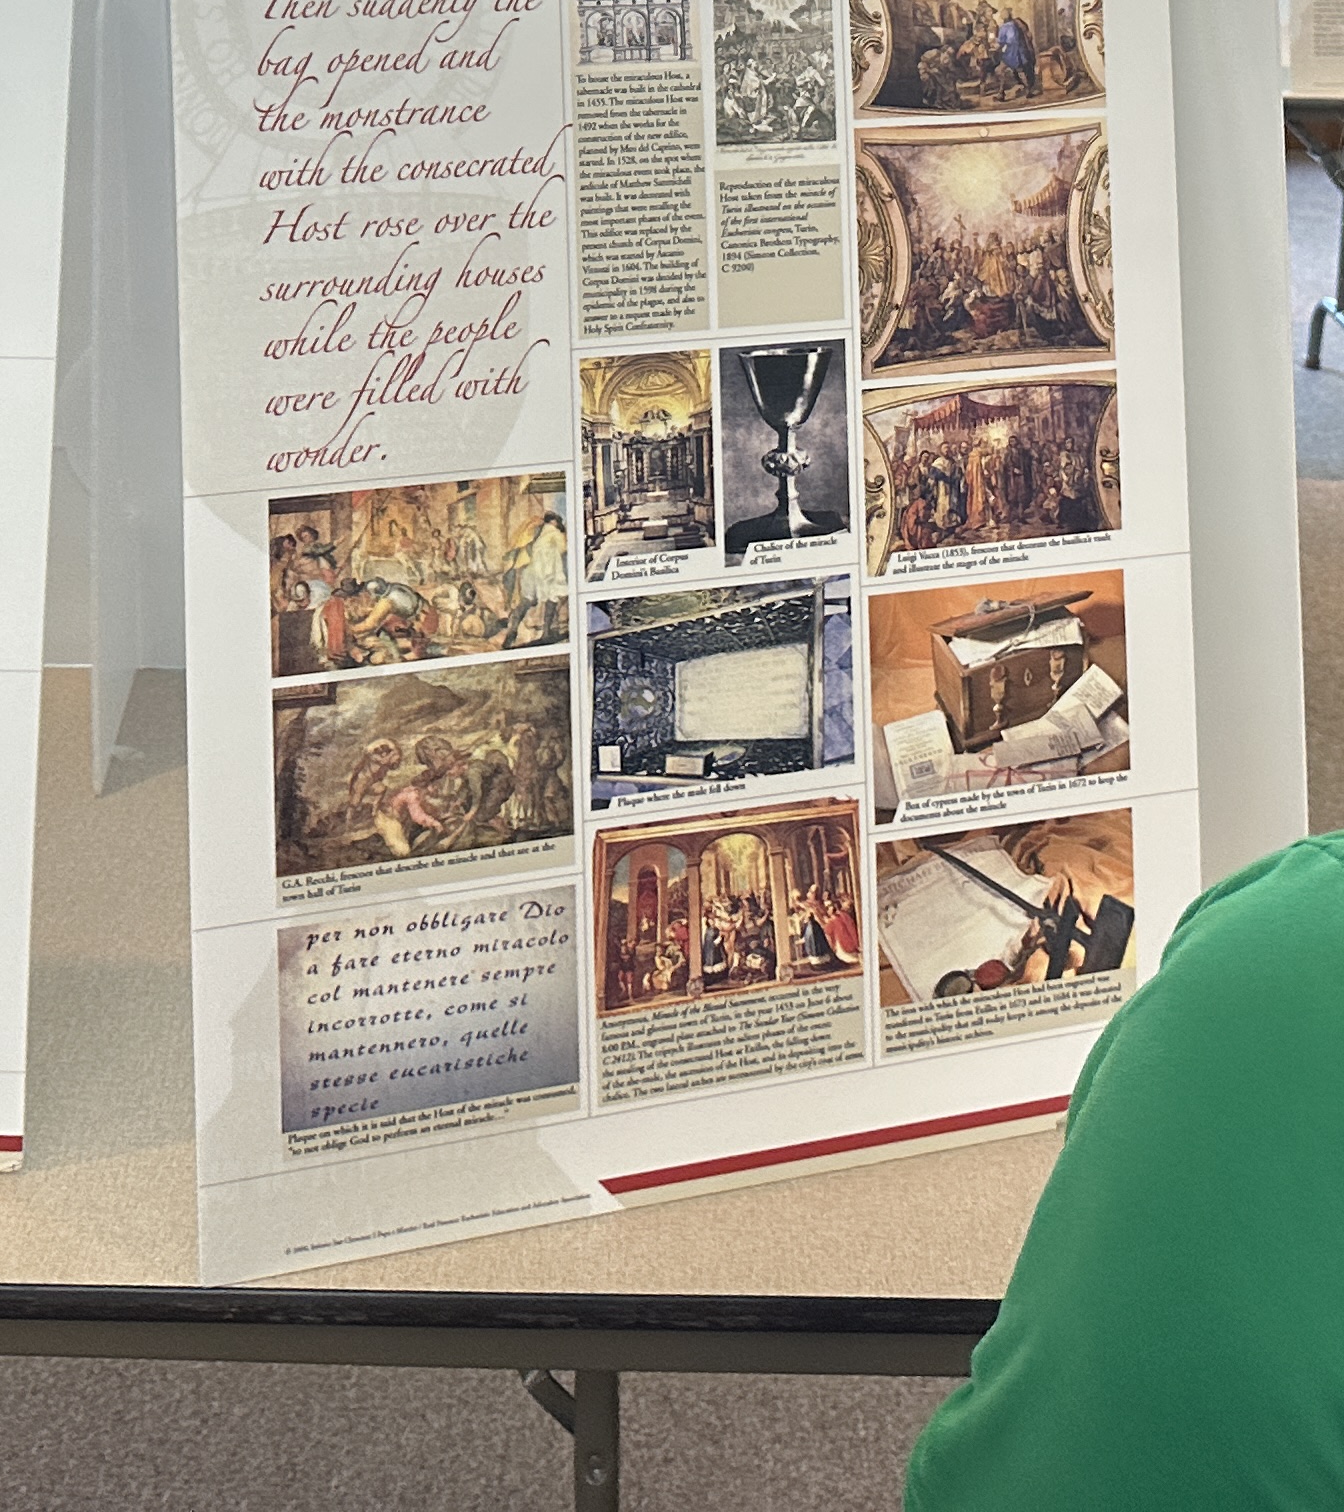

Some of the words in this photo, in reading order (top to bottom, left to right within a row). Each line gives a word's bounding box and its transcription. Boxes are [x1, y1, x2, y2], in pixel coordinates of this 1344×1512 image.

[320, 20, 450, 108] opened
[439, 17, 520, 71] and
[257, 76, 319, 133] the
[320, 98, 492, 129] monstrance
[259, 130, 353, 190] with
[340, 128, 397, 184] the
[397, 122, 573, 181] consecrated
[262, 203, 350, 245] Host
[360, 214, 425, 239] rose
[434, 212, 497, 235] over
[508, 174, 565, 230] the
[259, 240, 443, 328] surrounding
[456, 232, 547, 289] houses
[263, 299, 357, 360] while
[368, 293, 427, 350] the
[408, 290, 523, 380] people
[264, 389, 341, 417] were
[455, 338, 550, 401] with
[266, 411, 388, 473] wonder.
[760, 554, 782, 565] Turin
[307, 929, 342, 950] per
[355, 925, 395, 939] non
[406, 910, 509, 933] obbligare
[519, 901, 566, 920] Dio
[307, 963, 319, 976] a
[331, 954, 379, 977] fare
[391, 946, 461, 964] eterno
[473, 930, 569, 954] miracolo
[307, 985, 341, 1005] col
[481, 962, 557, 983] sempre
[307, 1009, 432, 1034] incorrotte,
[444, 998, 498, 1017] come
[508, 993, 528, 1008] si
[308, 1035, 449, 1063] mantennero,
[460, 1020, 529, 1046] quelle
[309, 1071, 379, 1091] stesse
[389, 1047, 529, 1081] eucaristiche
[310, 1096, 380, 1122] specie
